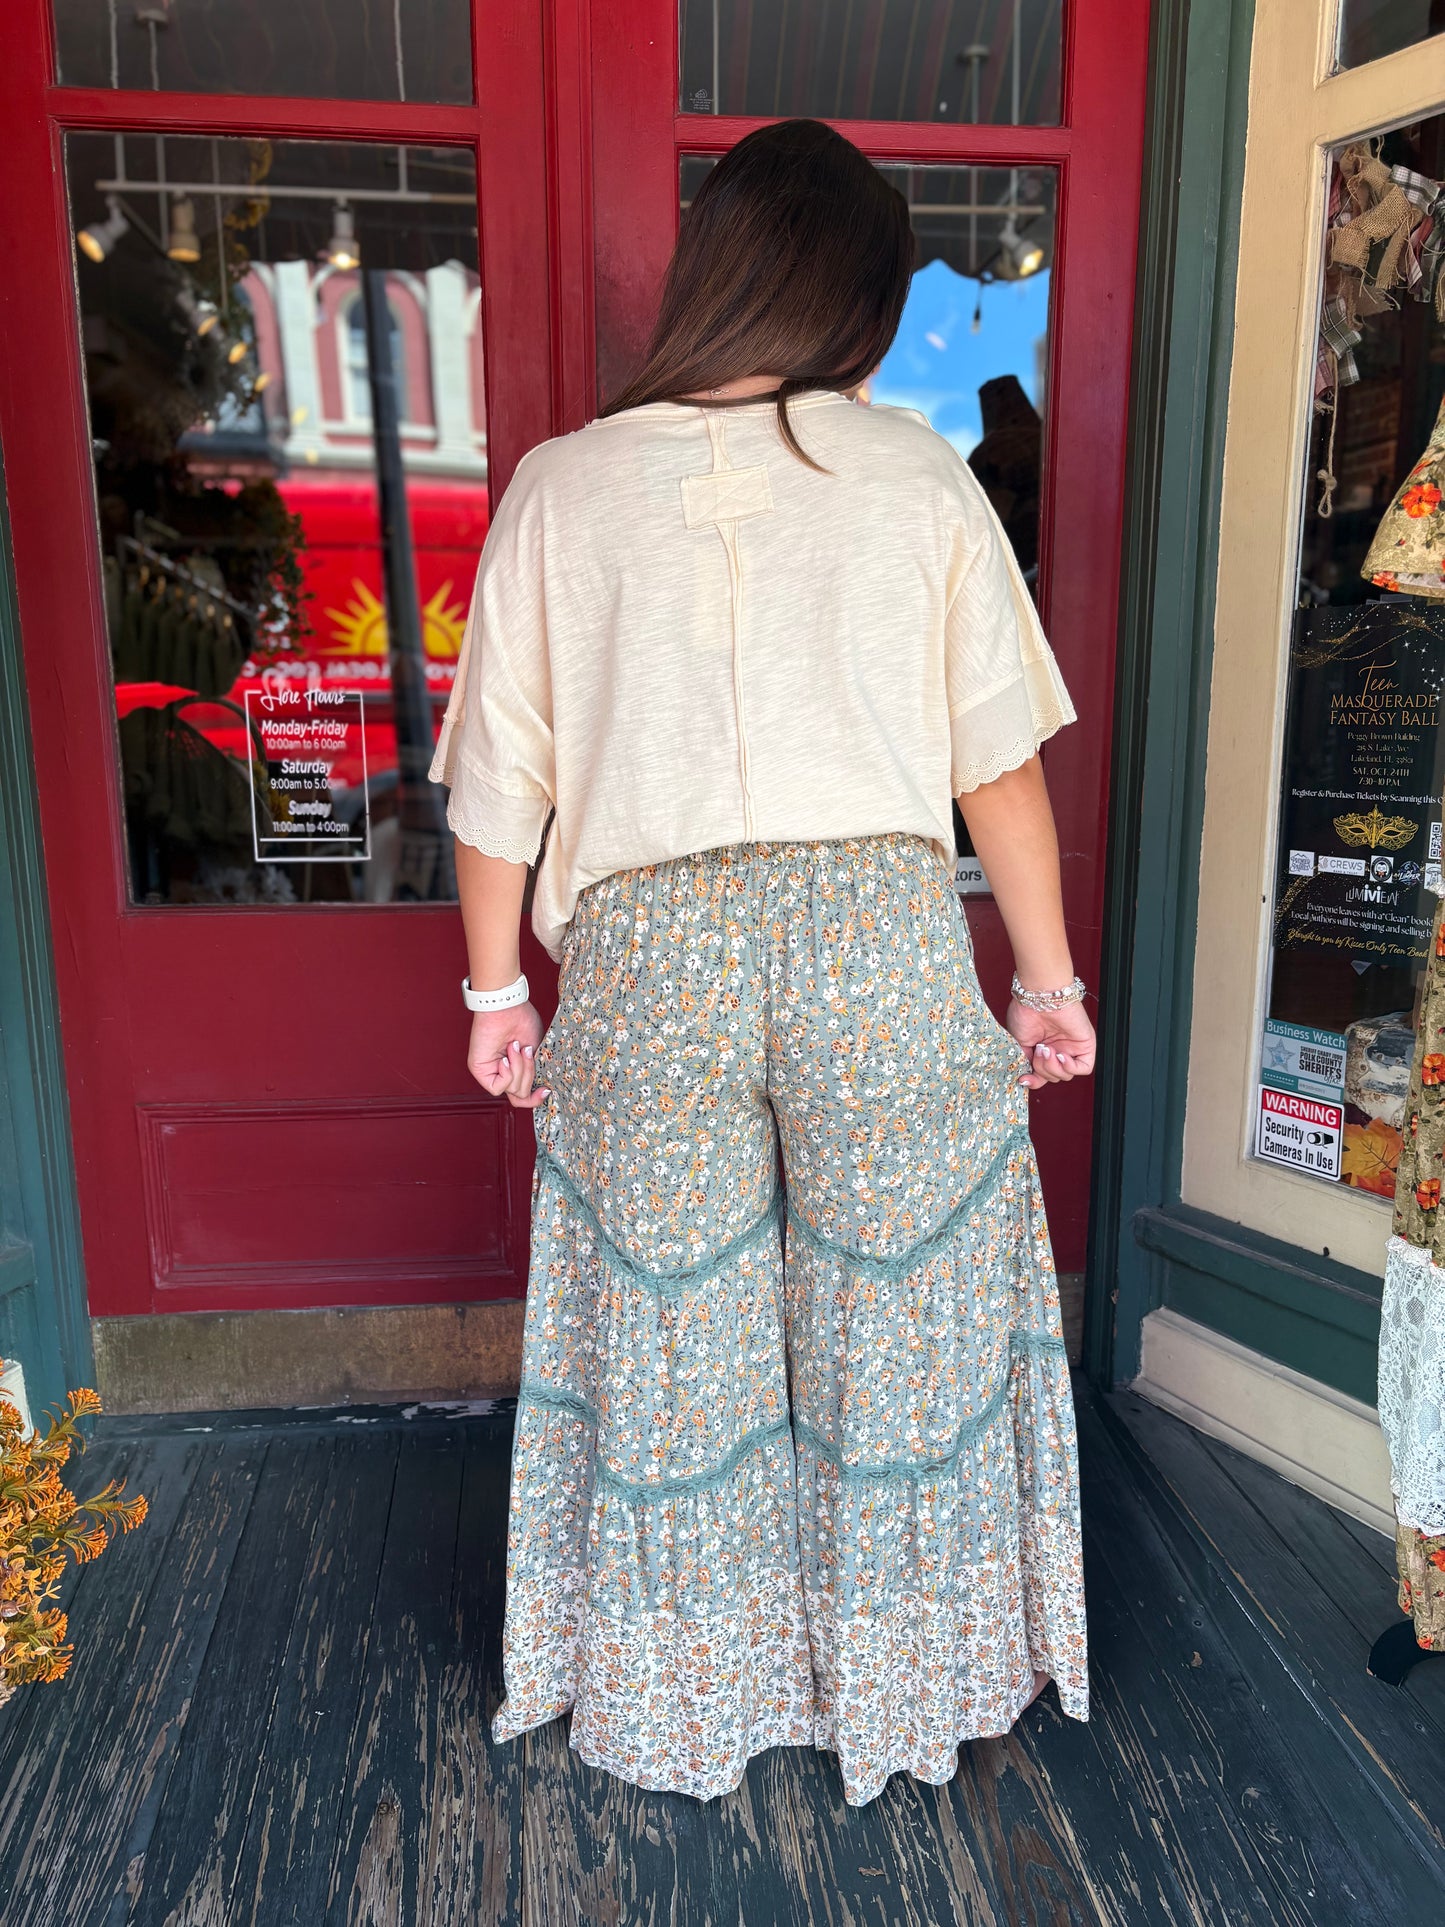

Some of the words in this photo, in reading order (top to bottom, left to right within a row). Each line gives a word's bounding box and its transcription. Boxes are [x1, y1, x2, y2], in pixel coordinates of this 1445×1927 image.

[260, 670, 301, 712] Store
[303, 677, 346, 712] Hours
[1358, 660, 1399, 708] Teen
[1331, 694, 1437, 712] MASQUERADE
[1330, 710, 1396, 726] FANTASY
[1401, 710, 1440, 726] BALL
[261, 719, 349, 738] Monday-Friday
[266, 738, 302, 750] 10:00am
[303, 739, 313, 750] to
[281, 758, 333, 777] Saturday
[270, 778, 302, 790] 9:00am
[303, 778, 313, 790] to
[1291, 788, 1318, 798] Register
[1318, 790, 1325, 798] &
[1325, 790, 1355, 800] Purchase
[1356, 791, 1380, 801] Tickets
[1380, 792, 1389, 803] by
[1390, 793, 1423, 805] Scanning
[1423, 795, 1437, 804] this
[288, 800, 333, 818] Sunday
[273, 821, 305, 833] 11:00am
[306, 821, 316, 833] to
[1329, 859, 1363, 871] CREWS
[1306, 902, 1338, 915] Everyone
[1338, 905, 1361, 917] leaves
[1361, 909, 1377, 920] with
[1291, 911, 1309, 921] Local
[1310, 913, 1337, 925] Authors
[1337, 917, 1349, 926] will
[1349, 918, 1359, 928] be
[1359, 920, 1385, 934] signing
[1385, 923, 1400, 934] and
[1401, 925, 1425, 940] selling
[1321, 936, 1335, 946] you
[1335, 936, 1344, 948] by
[1365, 940, 1387, 955] Only
[1387, 943, 1406, 955] Teen
[1266, 1021, 1310, 1041] Business
[1313, 1030, 1346, 1049] Watch
[1299, 1051, 1316, 1062] POLK
[1316, 1055, 1343, 1068] COUNTY
[1298, 1059, 1342, 1080] SHERIFF'S
[1266, 1093, 1338, 1126] WARNING
[1265, 1116, 1304, 1144] Security
[1264, 1136, 1303, 1158] Cameras
[1305, 1146, 1314, 1162] In
[1316, 1150, 1334, 1171] Use
